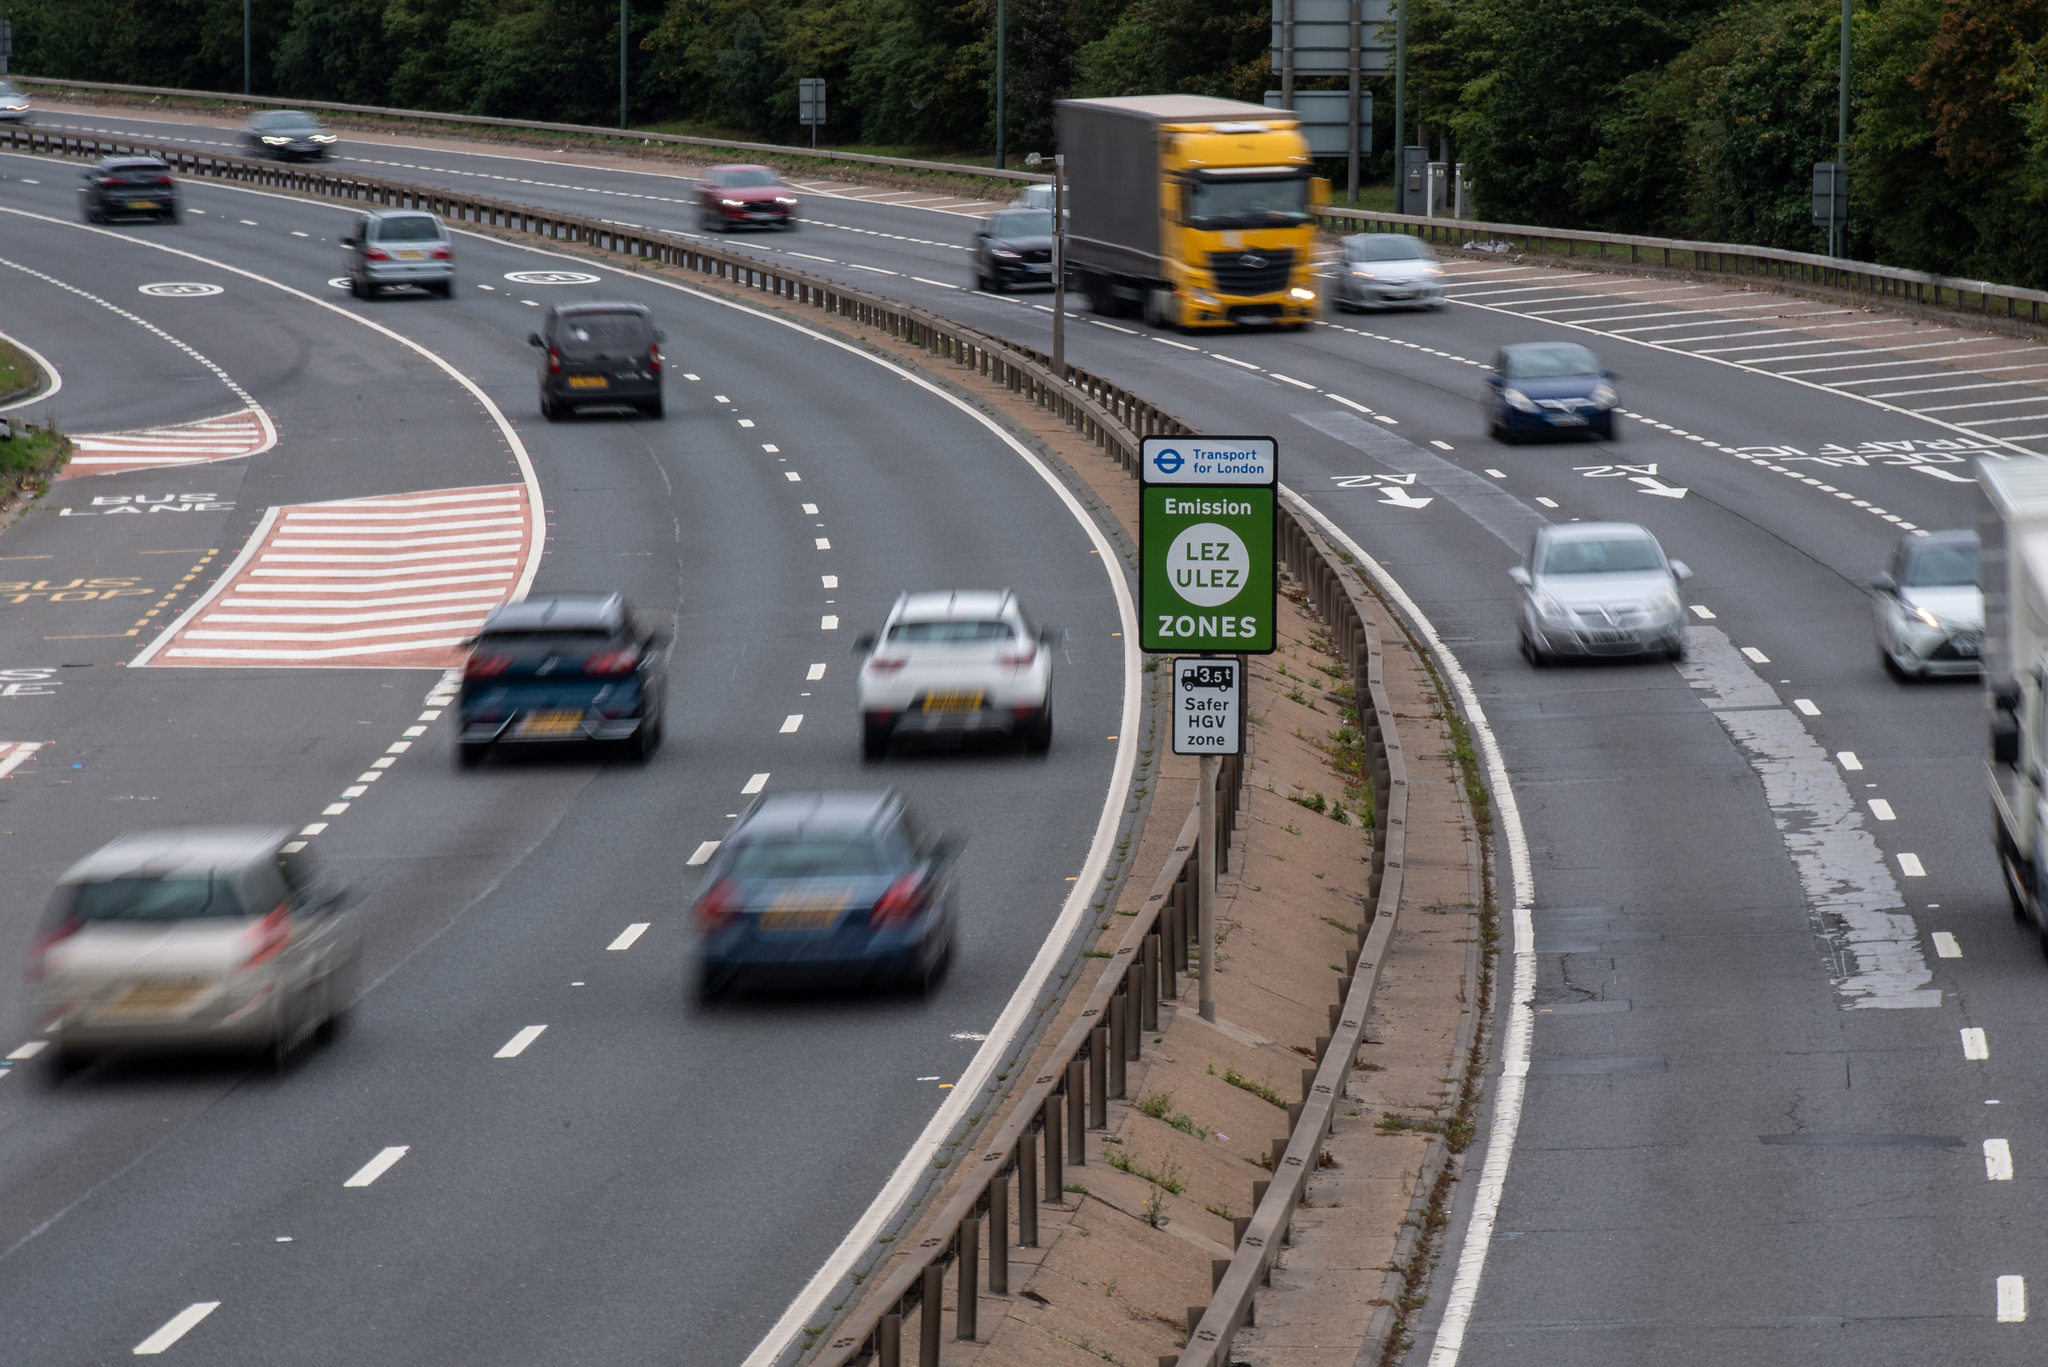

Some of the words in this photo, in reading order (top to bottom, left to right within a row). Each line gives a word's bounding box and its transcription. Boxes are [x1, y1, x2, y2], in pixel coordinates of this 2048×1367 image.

[1736, 437, 2002, 457] TRAFFIC
[1193, 449, 1257, 462] Transport
[1778, 449, 2011, 467] LOCAL
[1193, 463, 1212, 474] for
[1217, 463, 1264, 474] London
[1572, 463, 1658, 478] A2
[1330, 473, 1417, 487] A2
[89, 493, 218, 506] BUS
[1165, 498, 1252, 515] Emission
[58, 502, 238, 517] LANE
[1186, 542, 1230, 561] LEZ
[1176, 569, 1240, 588] ULEZ
[2, 588, 154, 604] TOP
[1158, 615, 1257, 638] ZONES
[1184, 697, 1230, 711] Safer
[1188, 715, 1226, 729] HGV
[1187, 735, 1225, 746] zone
